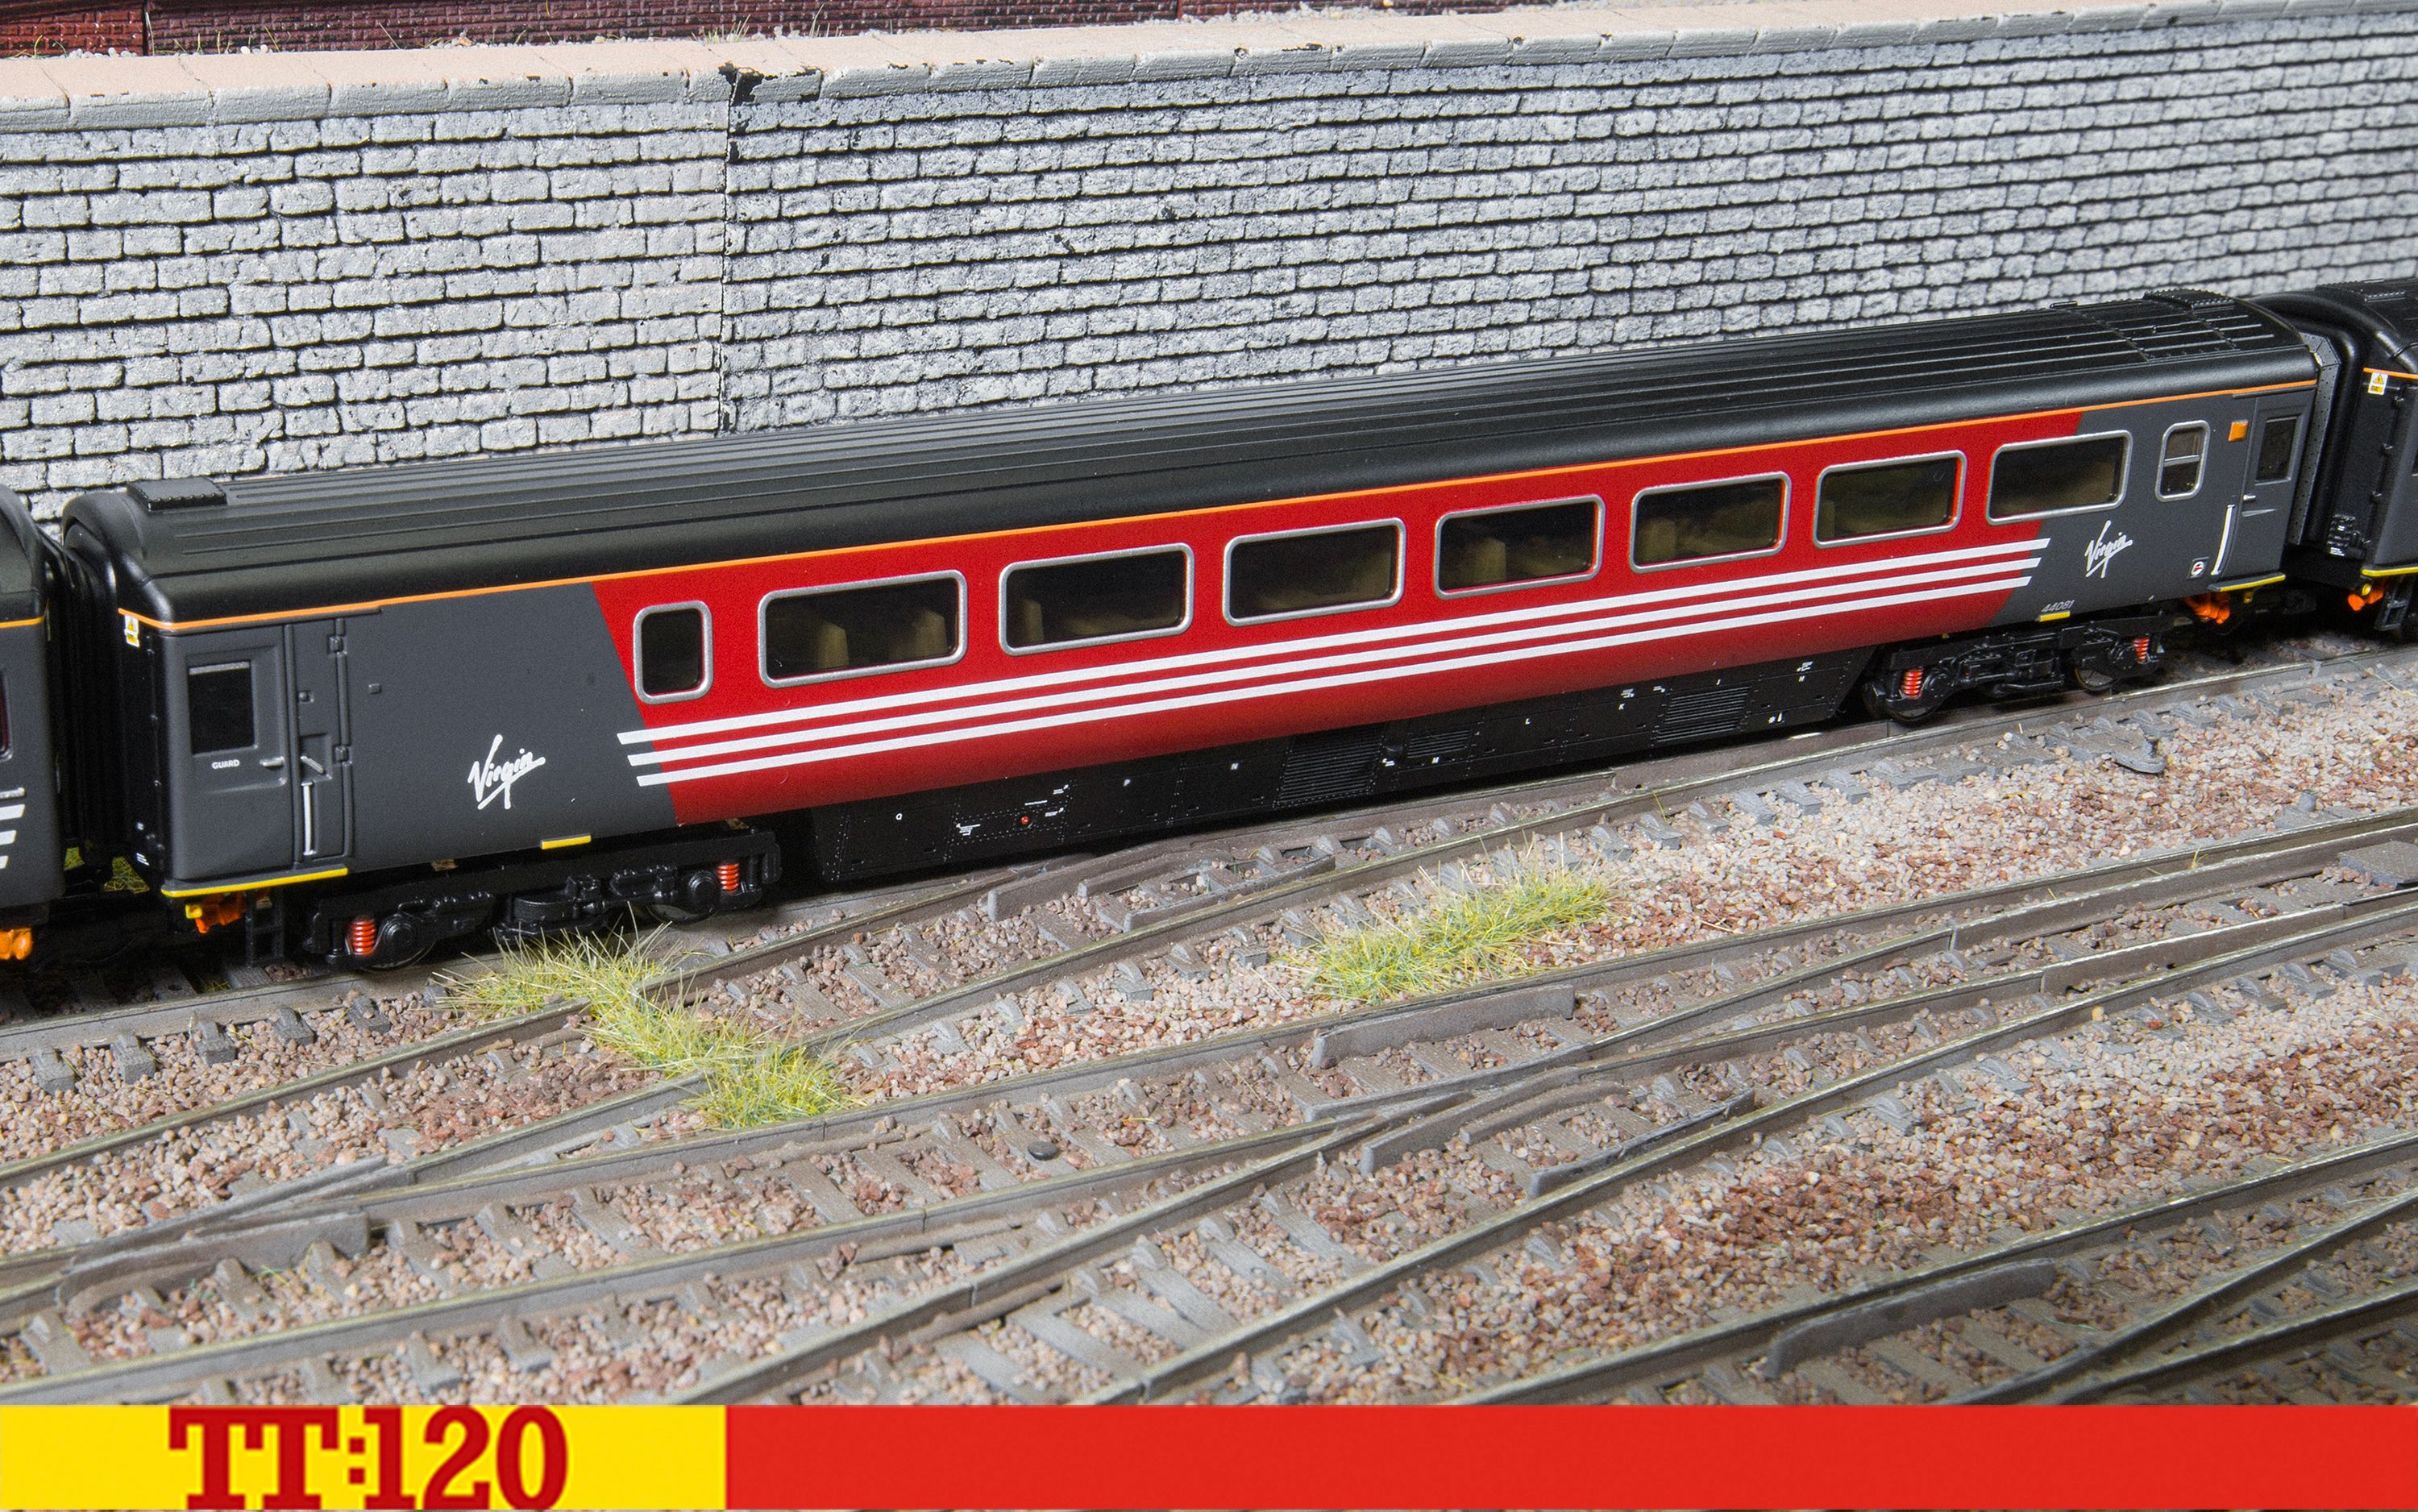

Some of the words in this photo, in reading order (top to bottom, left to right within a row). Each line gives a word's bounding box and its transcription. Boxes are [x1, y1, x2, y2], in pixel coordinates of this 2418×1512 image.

[2084, 520, 2133, 578] Virgin
[2042, 600, 2075, 613] 44081
[211, 759, 240, 770] GUARD
[467, 734, 546, 810] Virgin
